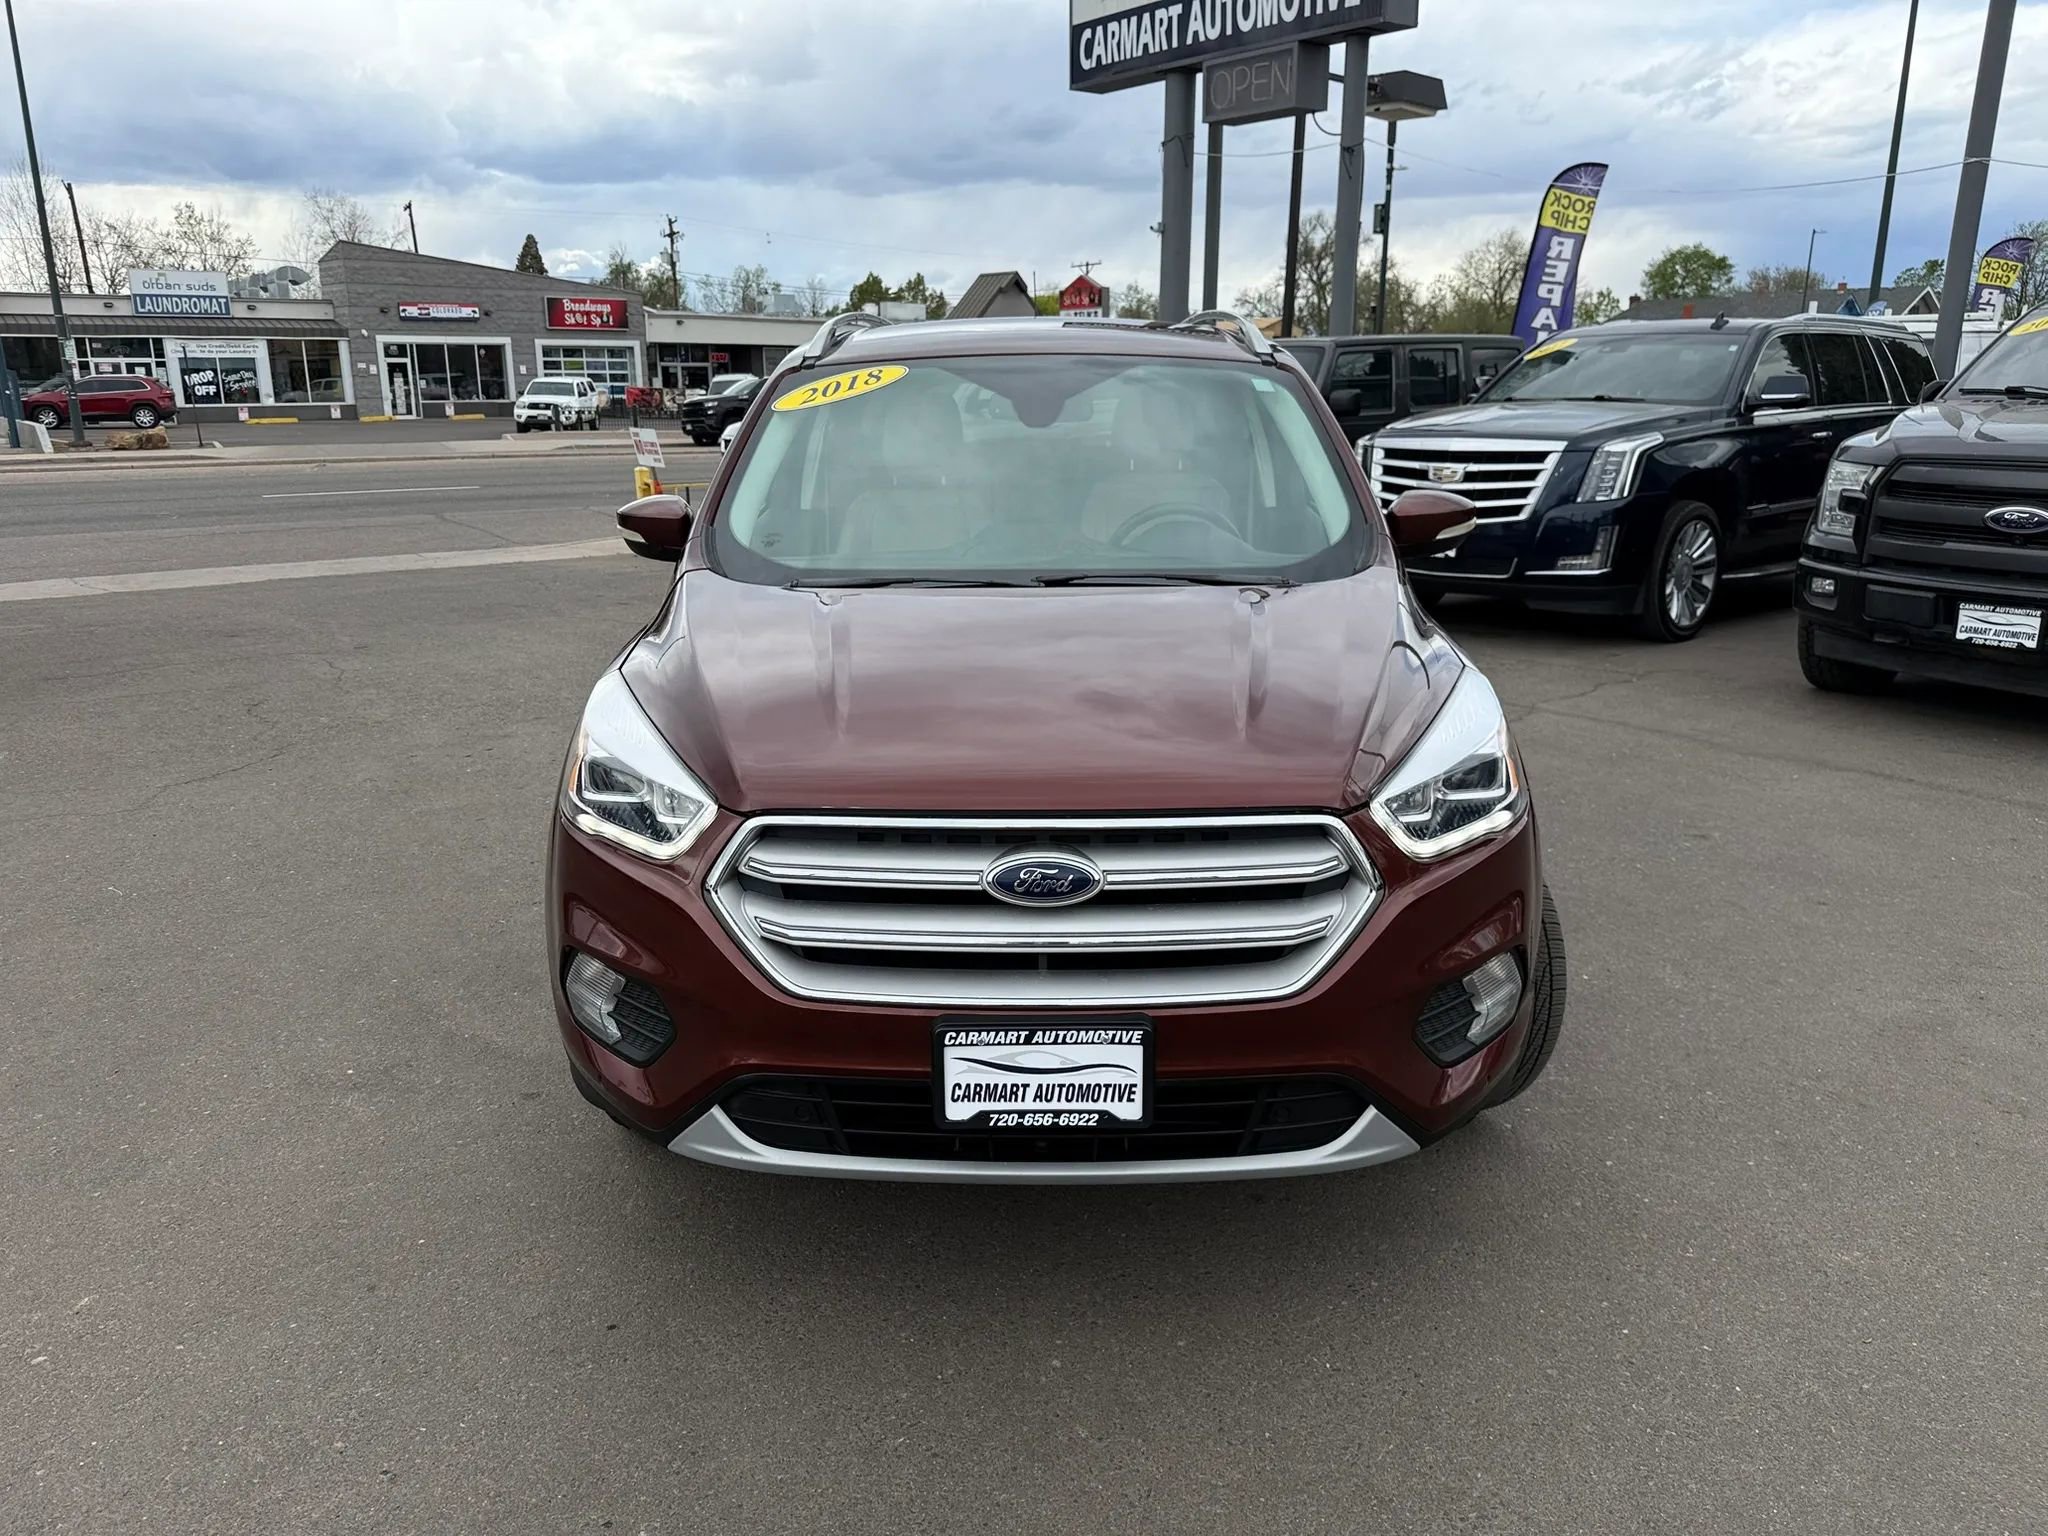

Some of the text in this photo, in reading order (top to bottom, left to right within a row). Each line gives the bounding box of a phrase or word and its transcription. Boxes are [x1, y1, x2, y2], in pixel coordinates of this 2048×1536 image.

[1079, 4, 1184, 71] CARMART
[1210, 56, 1293, 110] OPEN
[185, 281, 217, 292] suds
[136, 295, 227, 314] LAUNDROMAT
[194, 385, 217, 396] OFF
[799, 369, 883, 406] 2018
[1959, 602, 2042, 617] CARMART AUTOMOTIVE
[1959, 624, 2037, 642] CARMART AUTOMOTIVE
[1014, 867, 1074, 893] Ford
[944, 1030, 1144, 1045] CARMART AUTOMOTIVE
[951, 1082, 1138, 1104] CARMART AUTOMOTIVE
[989, 1113, 1100, 1126] 720-656-6922
